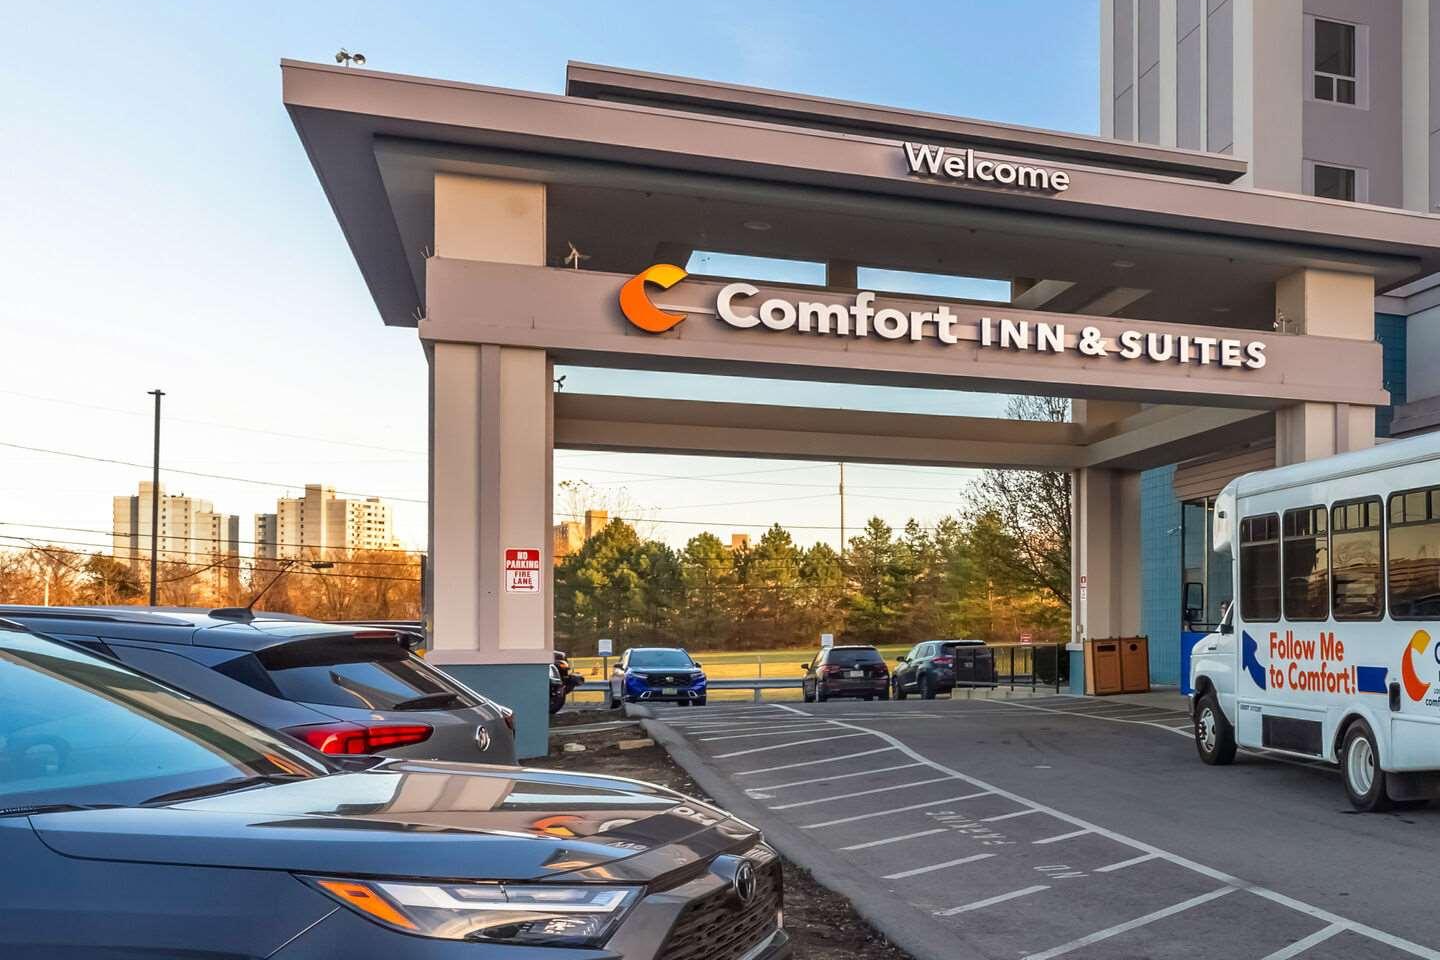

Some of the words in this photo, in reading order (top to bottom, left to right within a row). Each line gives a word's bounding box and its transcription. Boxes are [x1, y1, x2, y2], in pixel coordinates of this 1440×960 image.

[904, 142, 1070, 191] Welcome
[716, 283, 958, 344] Comfort
[980, 318, 1064, 352] INN
[1079, 327, 1108, 356] &
[1119, 331, 1267, 369] SUITES
[506, 560, 539, 569] PARKING
[517, 551, 528, 560] NO
[1269, 631, 1316, 660] Follow
[1320, 632, 1345, 661] Me
[1269, 664, 1284, 689] to
[1288, 661, 1356, 695] Comfort!
